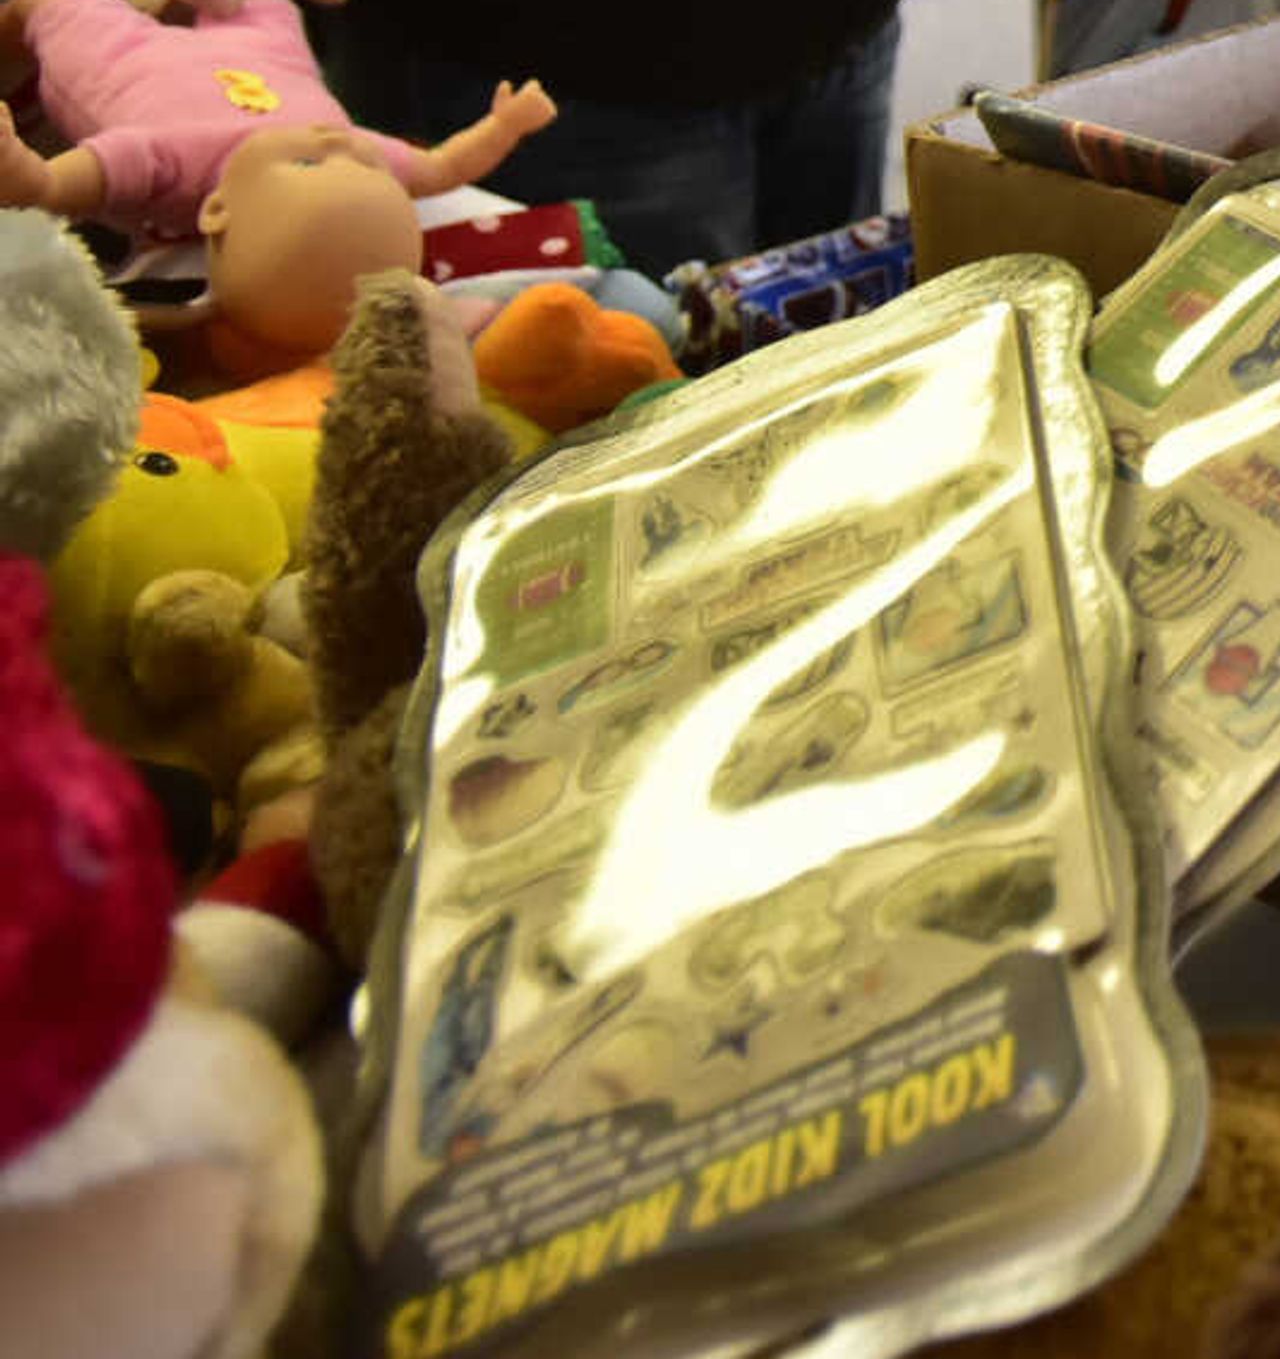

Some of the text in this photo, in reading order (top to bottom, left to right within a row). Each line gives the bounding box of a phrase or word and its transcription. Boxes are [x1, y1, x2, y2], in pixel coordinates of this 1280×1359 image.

[860, 1033, 1016, 1158] KOOL
[690, 1110, 842, 1231] KIDZ
[386, 1180, 685, 1359] MAGNETS
